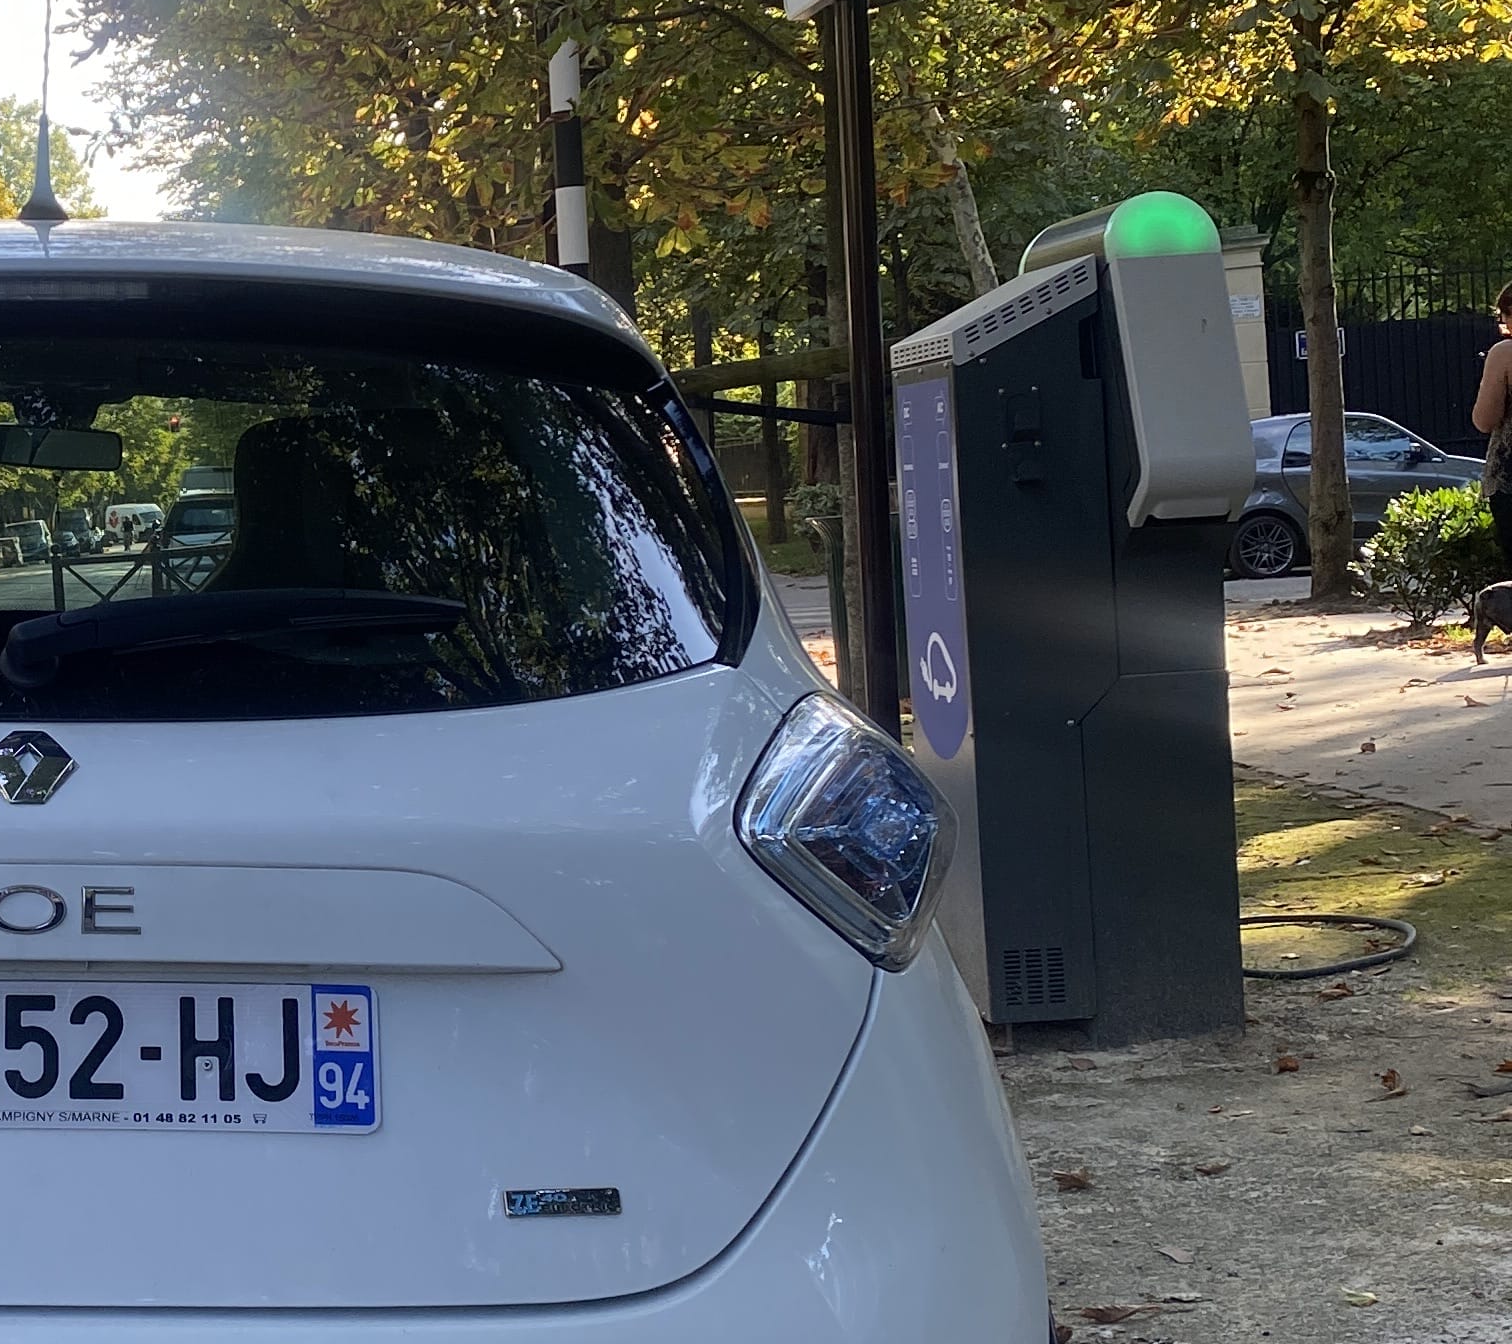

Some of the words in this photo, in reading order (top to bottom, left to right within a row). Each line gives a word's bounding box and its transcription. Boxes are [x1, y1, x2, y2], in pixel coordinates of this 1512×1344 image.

[317, 1061, 371, 1111] 94
[59, 1111, 121, 1124] S/MARNE
[132, 1113, 151, 1124] 01
[155, 1113, 174, 1124] 48
[178, 1113, 197, 1124] 82
[201, 1113, 218, 1124] 11
[223, 1113, 242, 1124] 05
